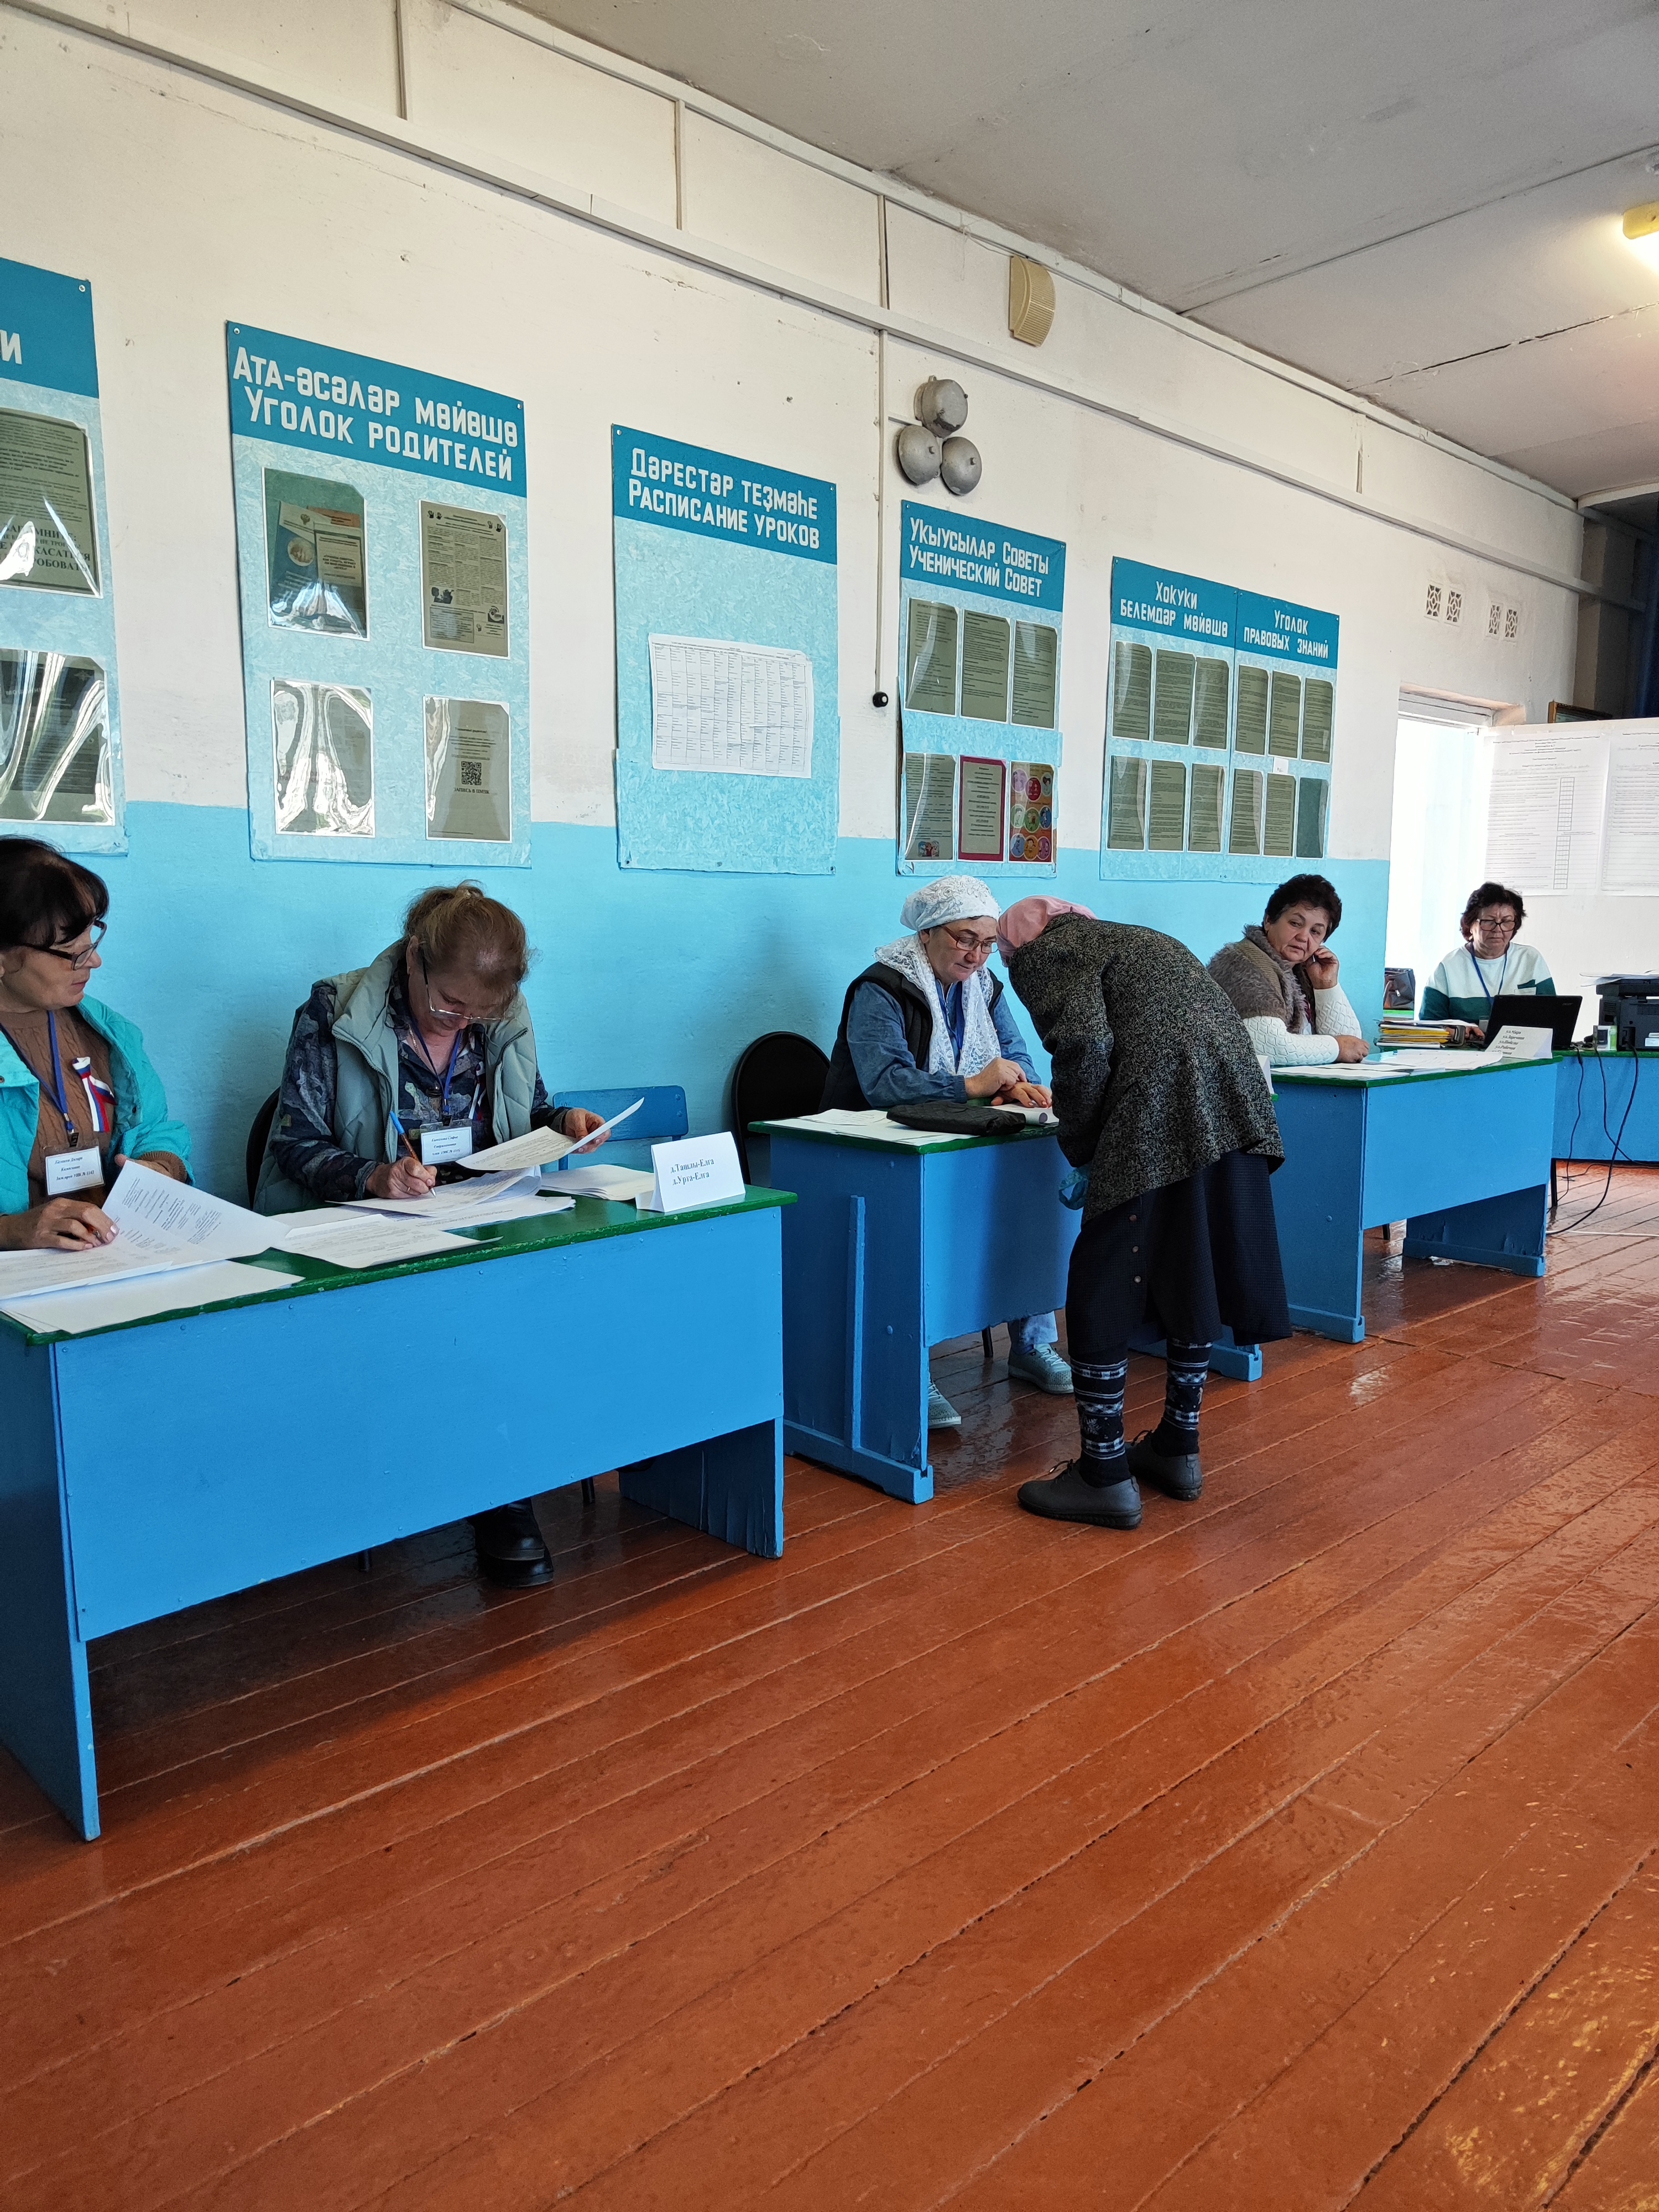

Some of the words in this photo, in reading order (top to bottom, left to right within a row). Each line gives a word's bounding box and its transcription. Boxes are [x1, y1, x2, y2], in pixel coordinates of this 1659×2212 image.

[244, 385, 354, 444] УГОЛОК
[368, 421, 512, 482] РОДИТЕЛЕЙ
[629, 478, 748, 533] РАСПИСАНИЕ
[754, 513, 820, 550] УРОКОВ
[909, 544, 1000, 587] УЧЕНИЧЕСКИЙ
[1004, 567, 1042, 597] СОВЕТ
[1003, 541, 1050, 575] СОВЕТЫ
[1274, 609, 1309, 636] УГОЛОК
[1244, 627, 1290, 652] ПРАВОВЫХ
[1297, 638, 1329, 659] ЗНАНИЙ
[670, 1158, 714, 1173] д.Ташлы-Елга
[672, 1171, 709, 1185] д.Урта-Елга
